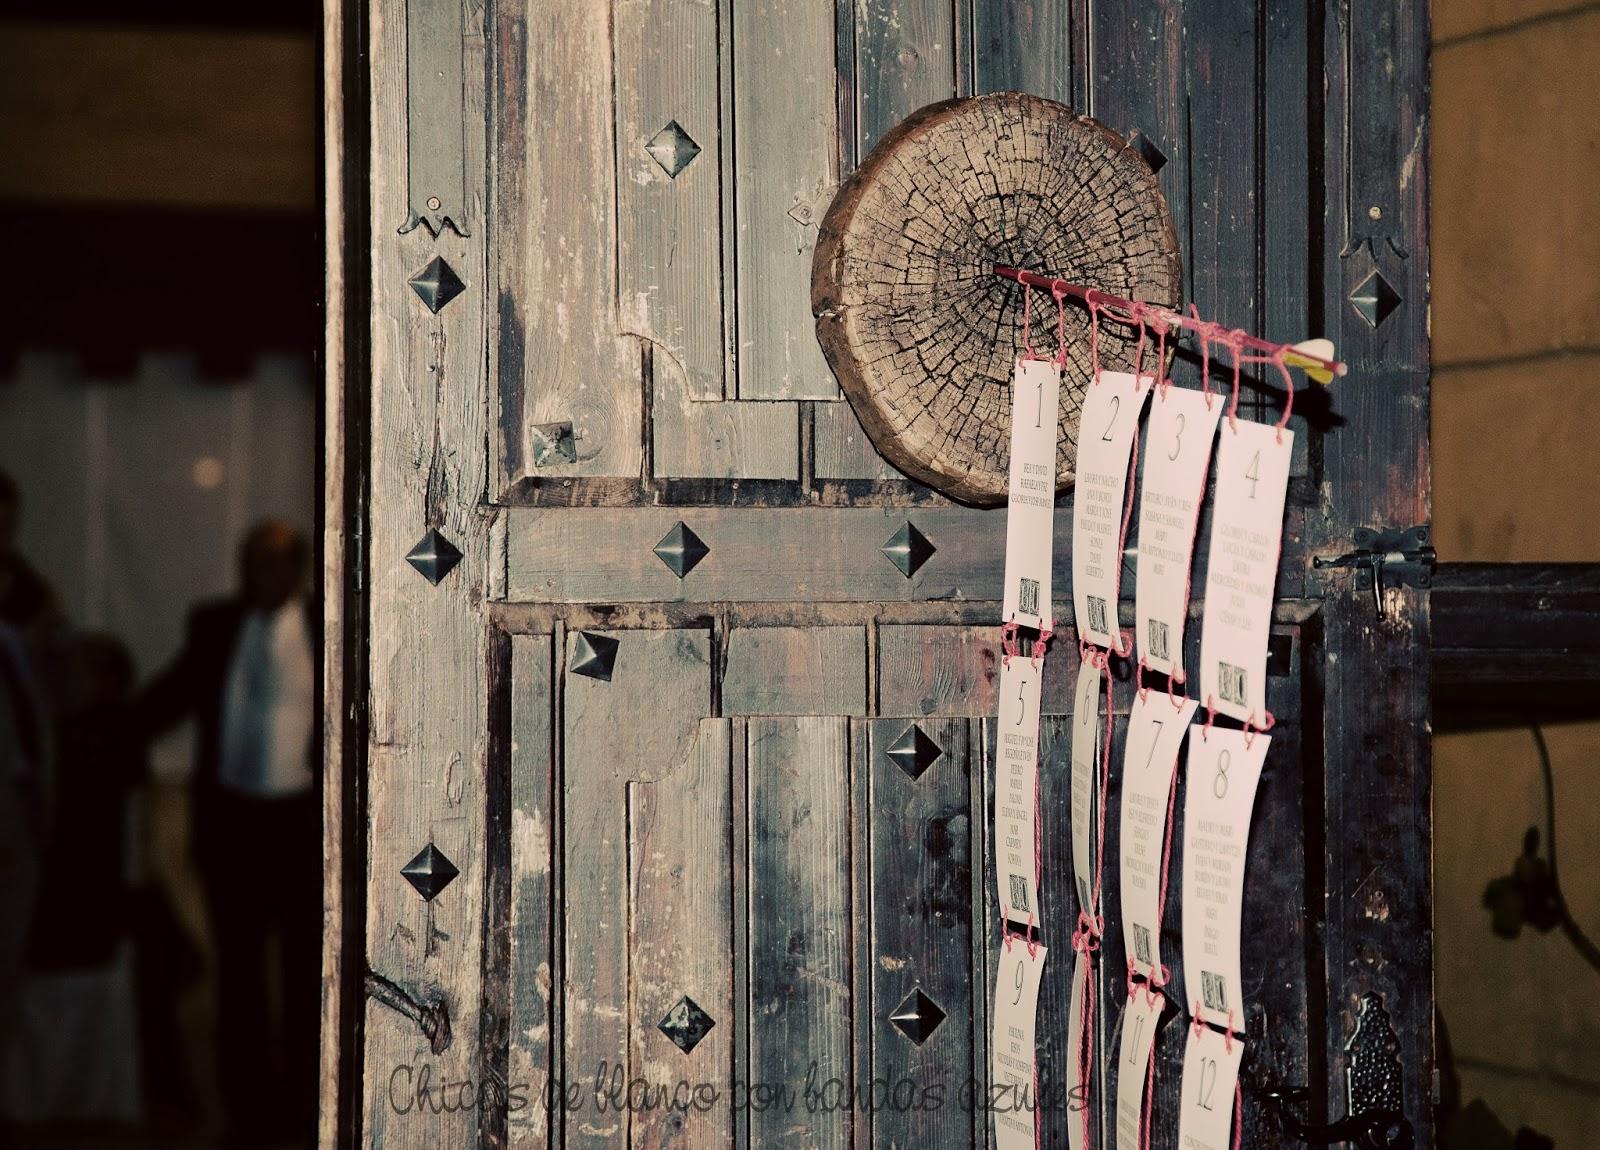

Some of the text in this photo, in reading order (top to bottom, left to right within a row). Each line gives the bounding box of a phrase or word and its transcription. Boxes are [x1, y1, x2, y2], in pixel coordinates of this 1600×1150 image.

[1035, 382, 1043, 428] 1
[1102, 395, 1120, 442] 2
[1167, 413, 1186, 461] 3
[1245, 450, 1260, 499] 4
[1016, 681, 1027, 726] 5
[1083, 679, 1093, 725] 6
[1146, 720, 1164, 769] 7
[1214, 749, 1231, 799] 8
[1013, 960, 1024, 1006] 9
[1128, 1015, 1144, 1065] 11
[1196, 1056, 1217, 1111] 12
